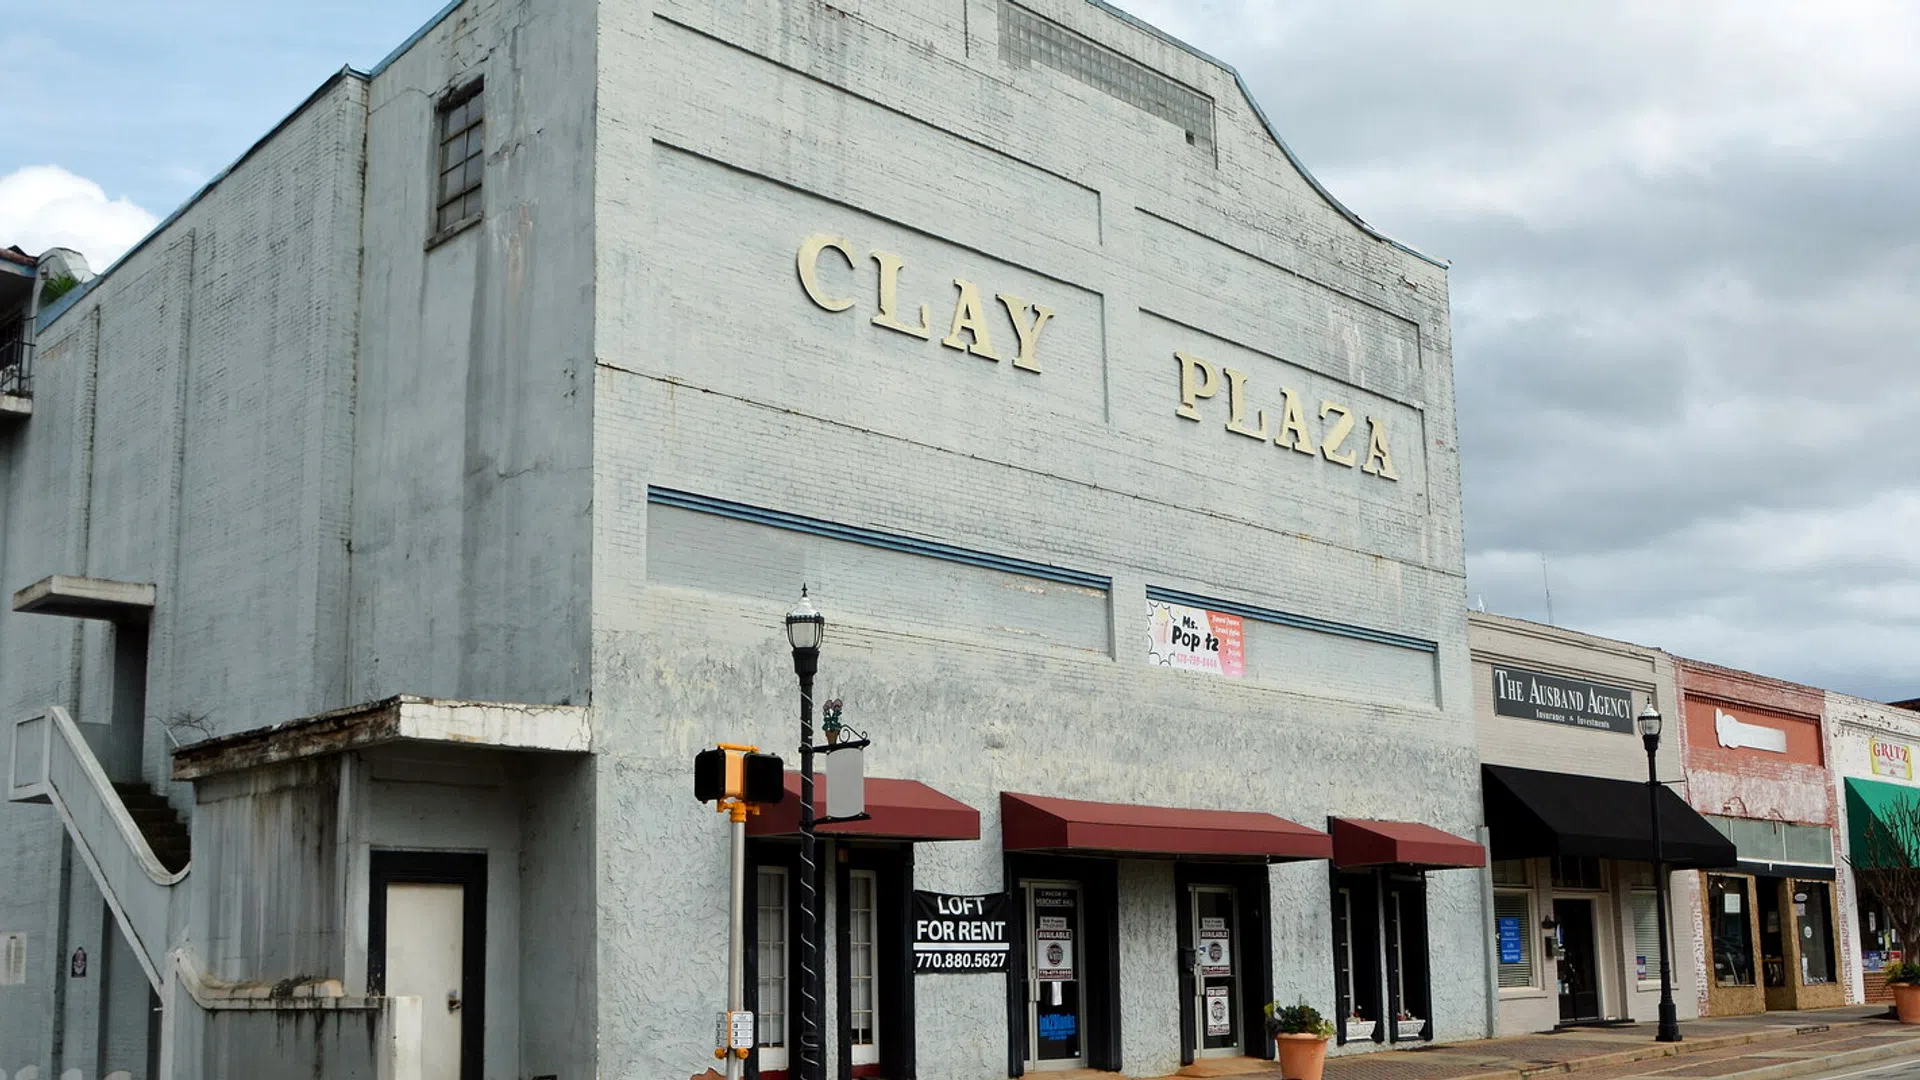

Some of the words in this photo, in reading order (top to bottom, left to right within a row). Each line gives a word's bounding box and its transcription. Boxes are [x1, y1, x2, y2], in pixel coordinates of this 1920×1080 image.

[796, 232, 1055, 374] CLAY
[1174, 351, 1400, 481] PLAZA
[1182, 615, 1199, 630] Ms.
[1171, 625, 1201, 652] Pop
[1494, 669, 1524, 702] THE
[1529, 676, 1584, 712] AUSBAND
[1588, 687, 1631, 720] AGENCY
[1536, 709, 1565, 722] Insurance
[1577, 715, 1611, 729] Investments
[1873, 743, 1908, 763] GRITZ
[937, 896, 985, 915] LOFT
[916, 920, 955, 941] FOR
[958, 921, 1006, 941] RENT
[915, 953, 1006, 968] 770.880.5627
